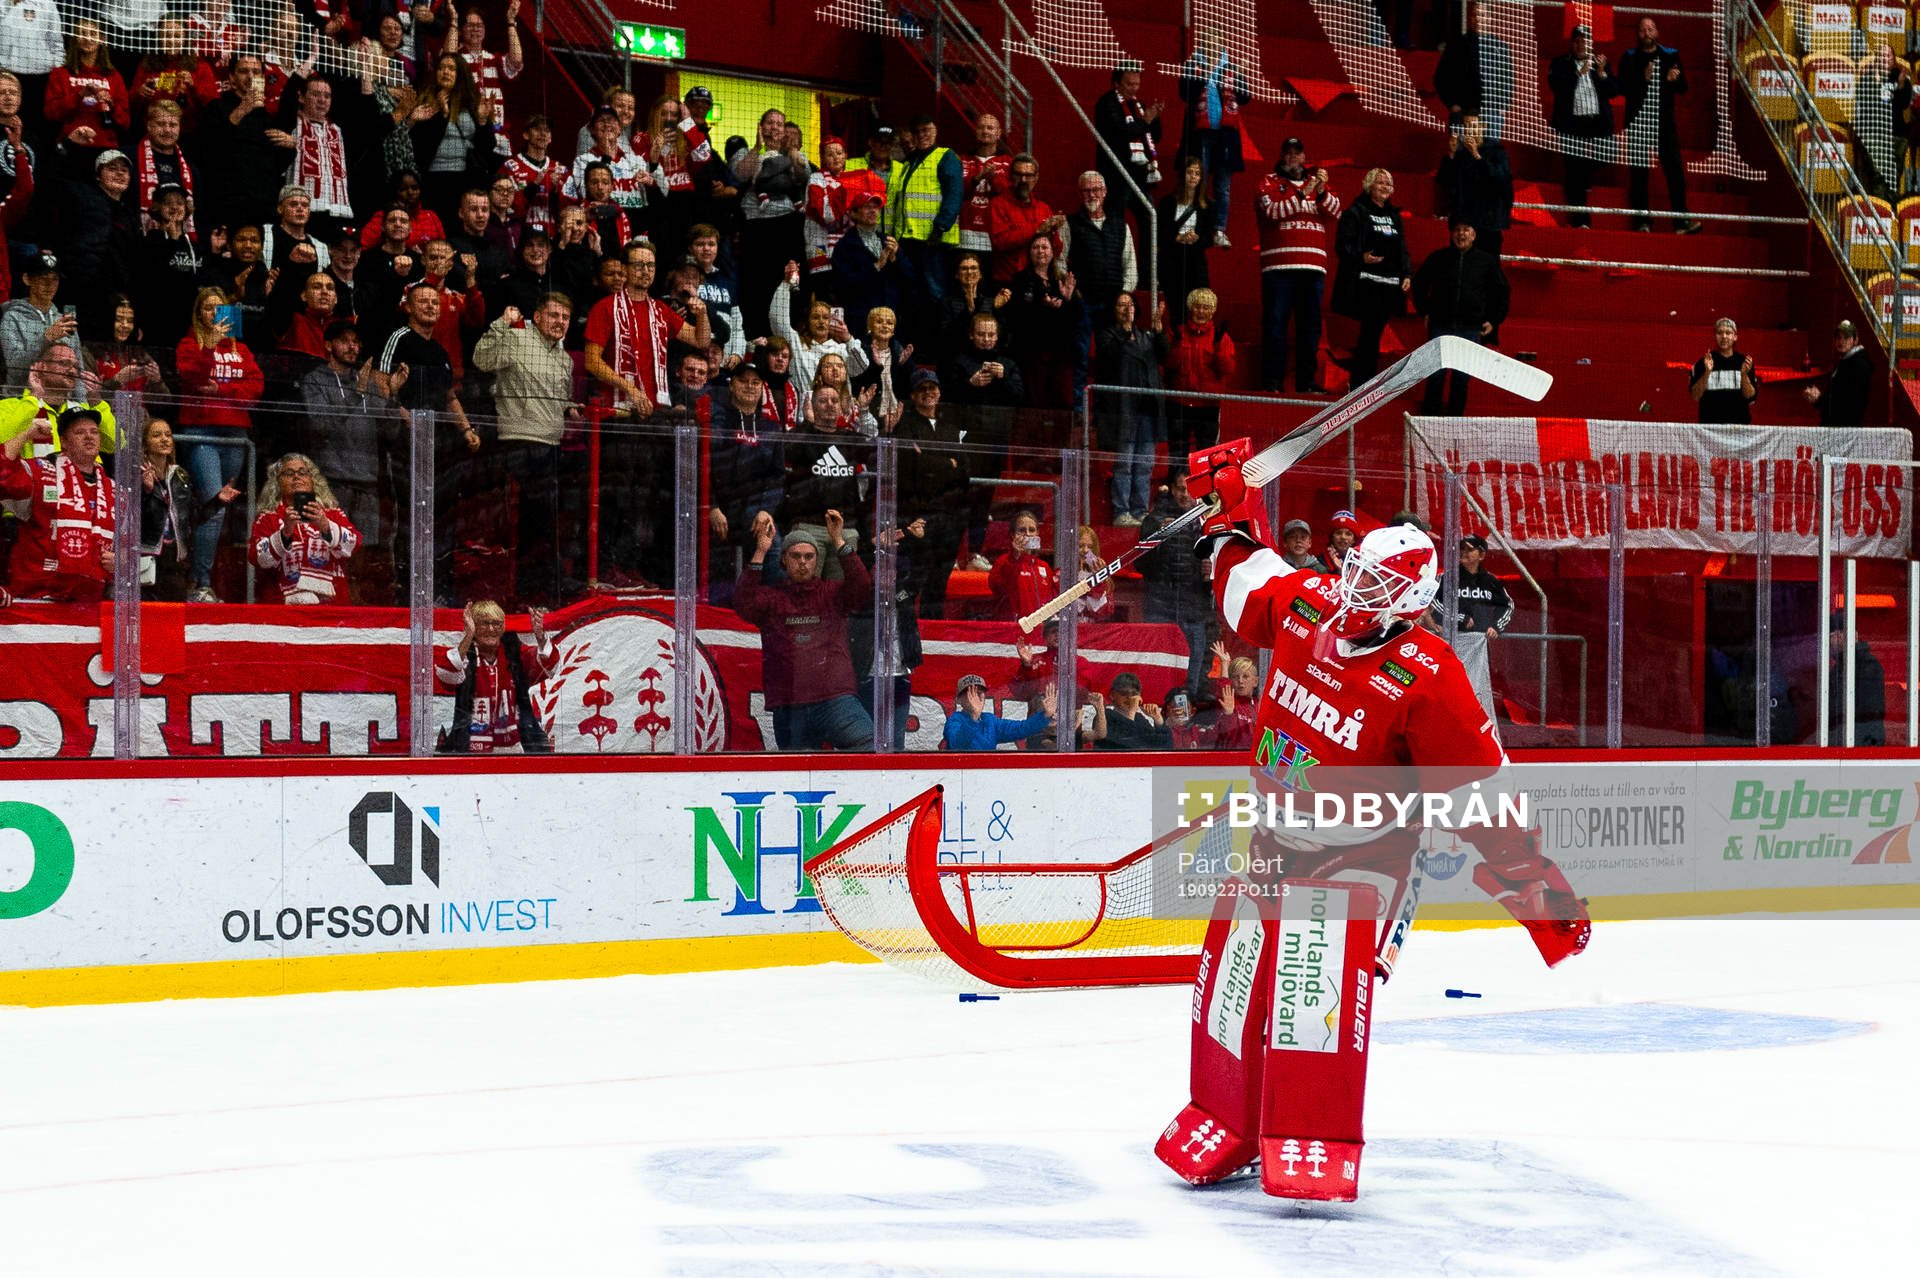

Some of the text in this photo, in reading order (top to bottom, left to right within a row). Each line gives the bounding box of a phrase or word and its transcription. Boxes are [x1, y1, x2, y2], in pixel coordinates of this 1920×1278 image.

[1760, 77, 1794, 89] MAI
[811, 463, 854, 477] adidas
[1842, 463, 1903, 538] OSS
[1457, 586, 1493, 600] didas
[1306, 663, 1343, 692] stadium
[1414, 652, 1440, 675] SCA
[1370, 674, 1404, 698] JOWIC
[1268, 668, 1366, 751] TIMRÅ
[1570, 782, 1601, 798] lottas
[1603, 785, 1615, 797] ut
[1617, 782, 1631, 797] till
[1633, 786, 1646, 797] en
[1648, 786, 1661, 796] av
[1663, 782, 1686, 796] våra
[1729, 779, 1904, 831] Byberg
[987, 800, 1014, 841] &
[684, 790, 869, 917] NHK
[1580, 857, 1597, 871] FÖR
[1599, 857, 1650, 870] FRAMTIDENS
[1651, 854, 1675, 868] TIMRÅ
[1676, 857, 1686, 867] IK
[1723, 832, 1853, 861] & Nordin
[222, 898, 557, 943] OLOFSSON INVEST
[1303, 888, 1329, 1007] norrlands
[1192, 949, 1213, 1024] BAUER
[1234, 924, 1263, 1017] miljövar
[1218, 940, 1246, 1047] norrlands
[1352, 967, 1369, 1053] BAUER
